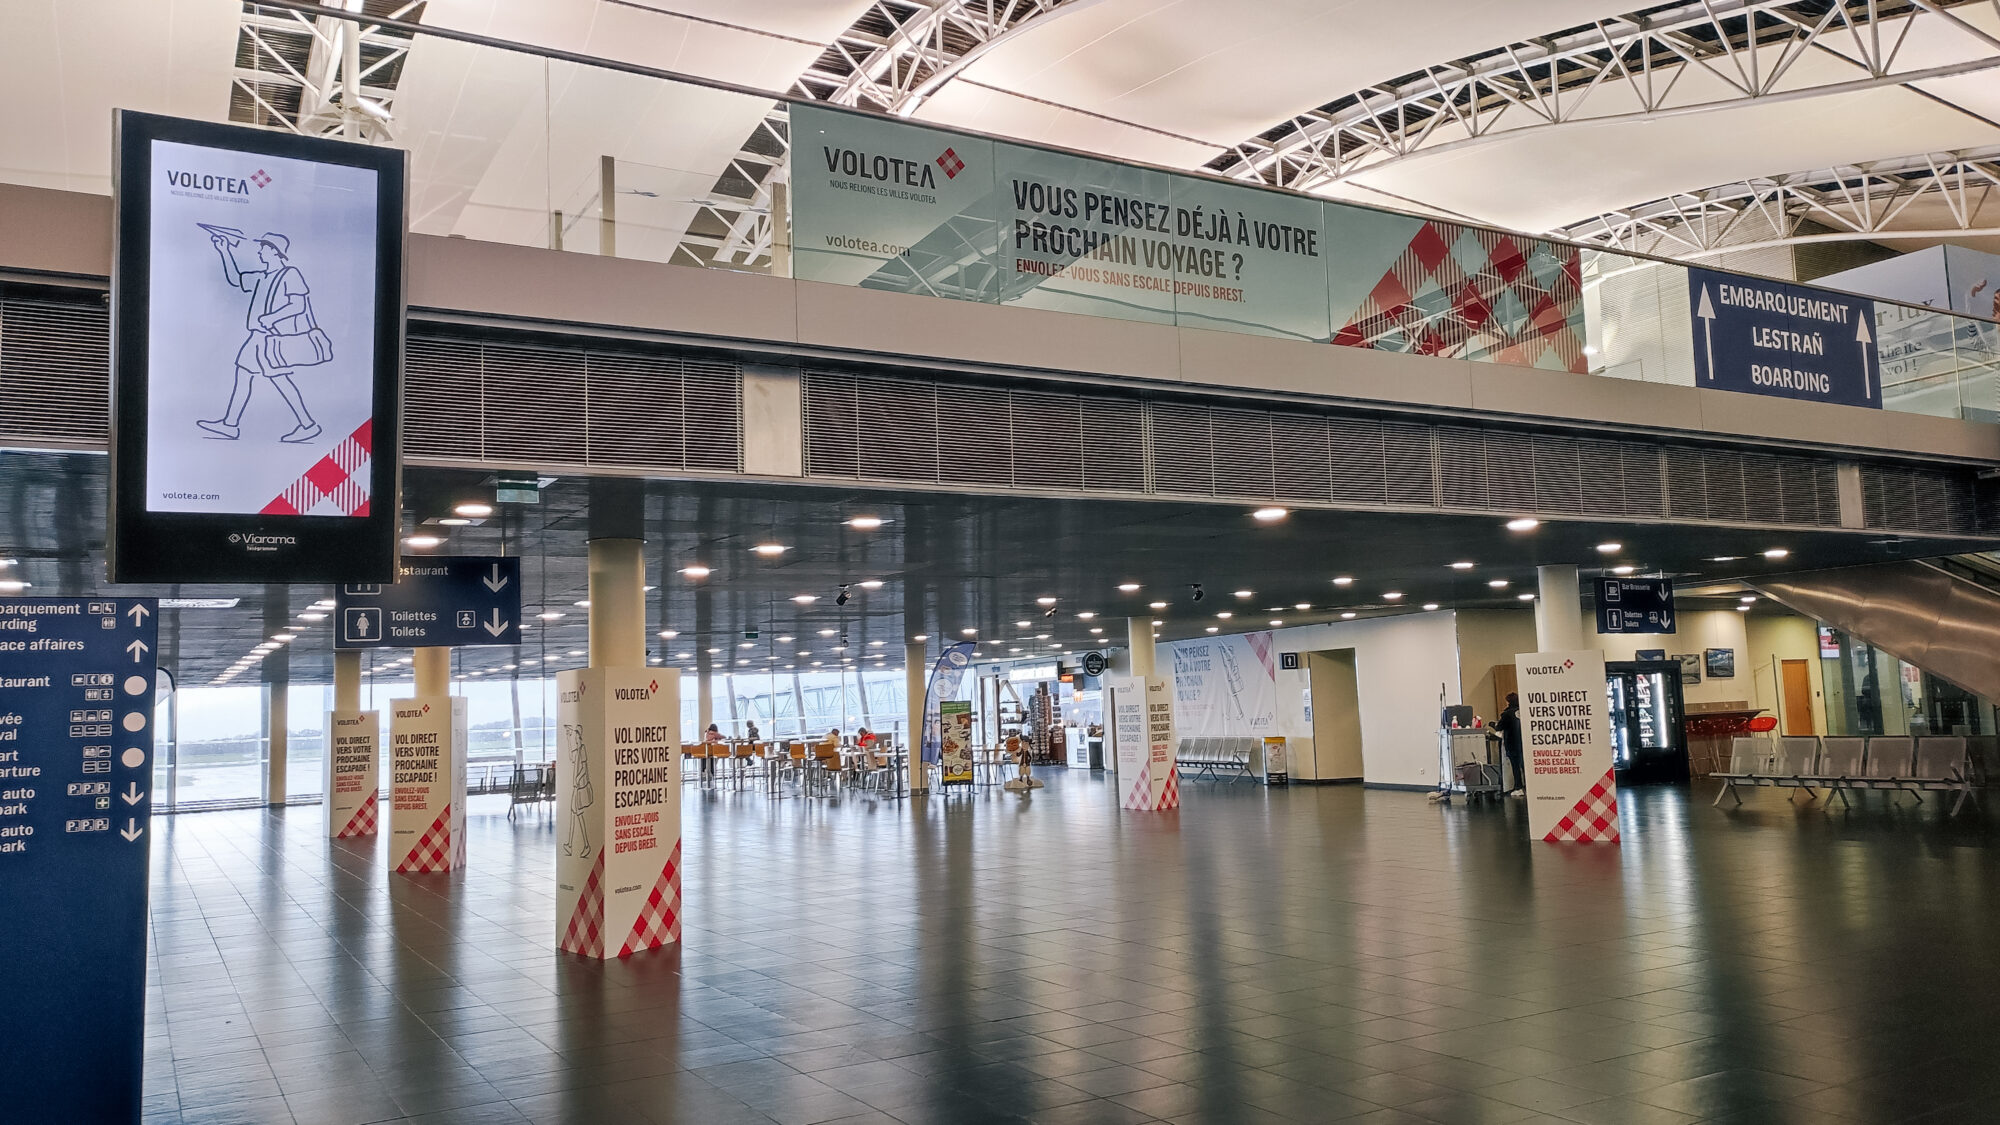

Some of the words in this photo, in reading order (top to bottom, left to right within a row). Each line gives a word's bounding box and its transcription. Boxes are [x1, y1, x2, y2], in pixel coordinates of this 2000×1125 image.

[824, 146, 936, 189] VOLOTEA
[167, 170, 249, 195] VOLOTEA
[830, 180, 848, 190] NOUS
[849, 182, 876, 195] RELIONS
[876, 187, 888, 197] LES
[888, 189, 909, 200] VILLES
[909, 192, 937, 205] VOLOTEA
[1013, 180, 1078, 219] VOUS
[1085, 192, 1170, 234] PENSEZ
[1177, 205, 1232, 244] DÉJÀ
[1236, 212, 1250, 246] À
[1254, 220, 1319, 257] VOTRE
[826, 235, 911, 257] volotea.com
[1015, 219, 1137, 266] PROCHAIN
[1142, 238, 1227, 279] VOYAGE
[1231, 253, 1244, 281] ?
[1016, 258, 1100, 284] ENVOLEZ-VOUS
[1102, 270, 1131, 287] SANS
[1133, 274, 1171, 293] ESCALE
[1173, 280, 1211, 299] DEPUIS
[1213, 286, 1246, 303] BREST.
[1720, 283, 1849, 324] EMBARQUEMENT
[1752, 326, 1824, 356] LESTRAÑ
[1751, 364, 1830, 394] BOARDING
[163, 492, 220, 500] volotea.com
[242, 533, 296, 545] Viarama
[391, 611, 437, 621] Toilettes
[0, 618, 38, 633] rding
[391, 626, 426, 637] Toilets
[29, 639, 85, 651] affaires
[1526, 666, 1564, 675] VOLOTEA
[614, 688, 650, 700] VOLOTEA
[1528, 692, 1547, 703] VOL
[1550, 690, 1588, 703] DIRECT
[395, 710, 422, 718] VOLOTEA
[1529, 706, 1556, 717] VERS
[1558, 705, 1592, 717] VOTRE
[1530, 719, 1592, 731] PROCHAINE
[336, 737, 348, 745] VOL
[349, 736, 370, 744] DIRECT
[395, 734, 409, 744] VOL
[410, 733, 437, 744] DIRECT
[614, 727, 633, 744] VOL
[635, 726, 667, 743] DIRECT
[1532, 733, 1586, 745] ESCAPADE
[1588, 733, 1592, 744] !
[336, 746, 352, 754] VERS
[395, 747, 414, 757] VERS
[415, 746, 440, 757] VOTRE
[614, 748, 639, 765] VERS
[641, 746, 670, 763] VOTRE
[1533, 749, 1582, 757] ENVOLEZ-VOUS
[336, 754, 371, 764] PROCHAINE
[395, 759, 438, 770] PROCHAINE
[1533, 758, 1551, 766] SANS
[1552, 758, 1576, 766] ESCALE
[336, 764, 366, 773] ESCAPADE
[395, 772, 433, 783] ESCAPADE
[615, 767, 668, 787] PROCHAINE
[2, 788, 36, 800] auto
[615, 788, 663, 809] ESCAPADE
[664, 787, 668, 803] !
[615, 812, 659, 827] ENVOLEZ-VOUS
[1, 825, 34, 837] auto
[615, 828, 631, 840] SANS
[632, 825, 654, 838] ESCALE
[615, 841, 637, 853] DEPUIS
